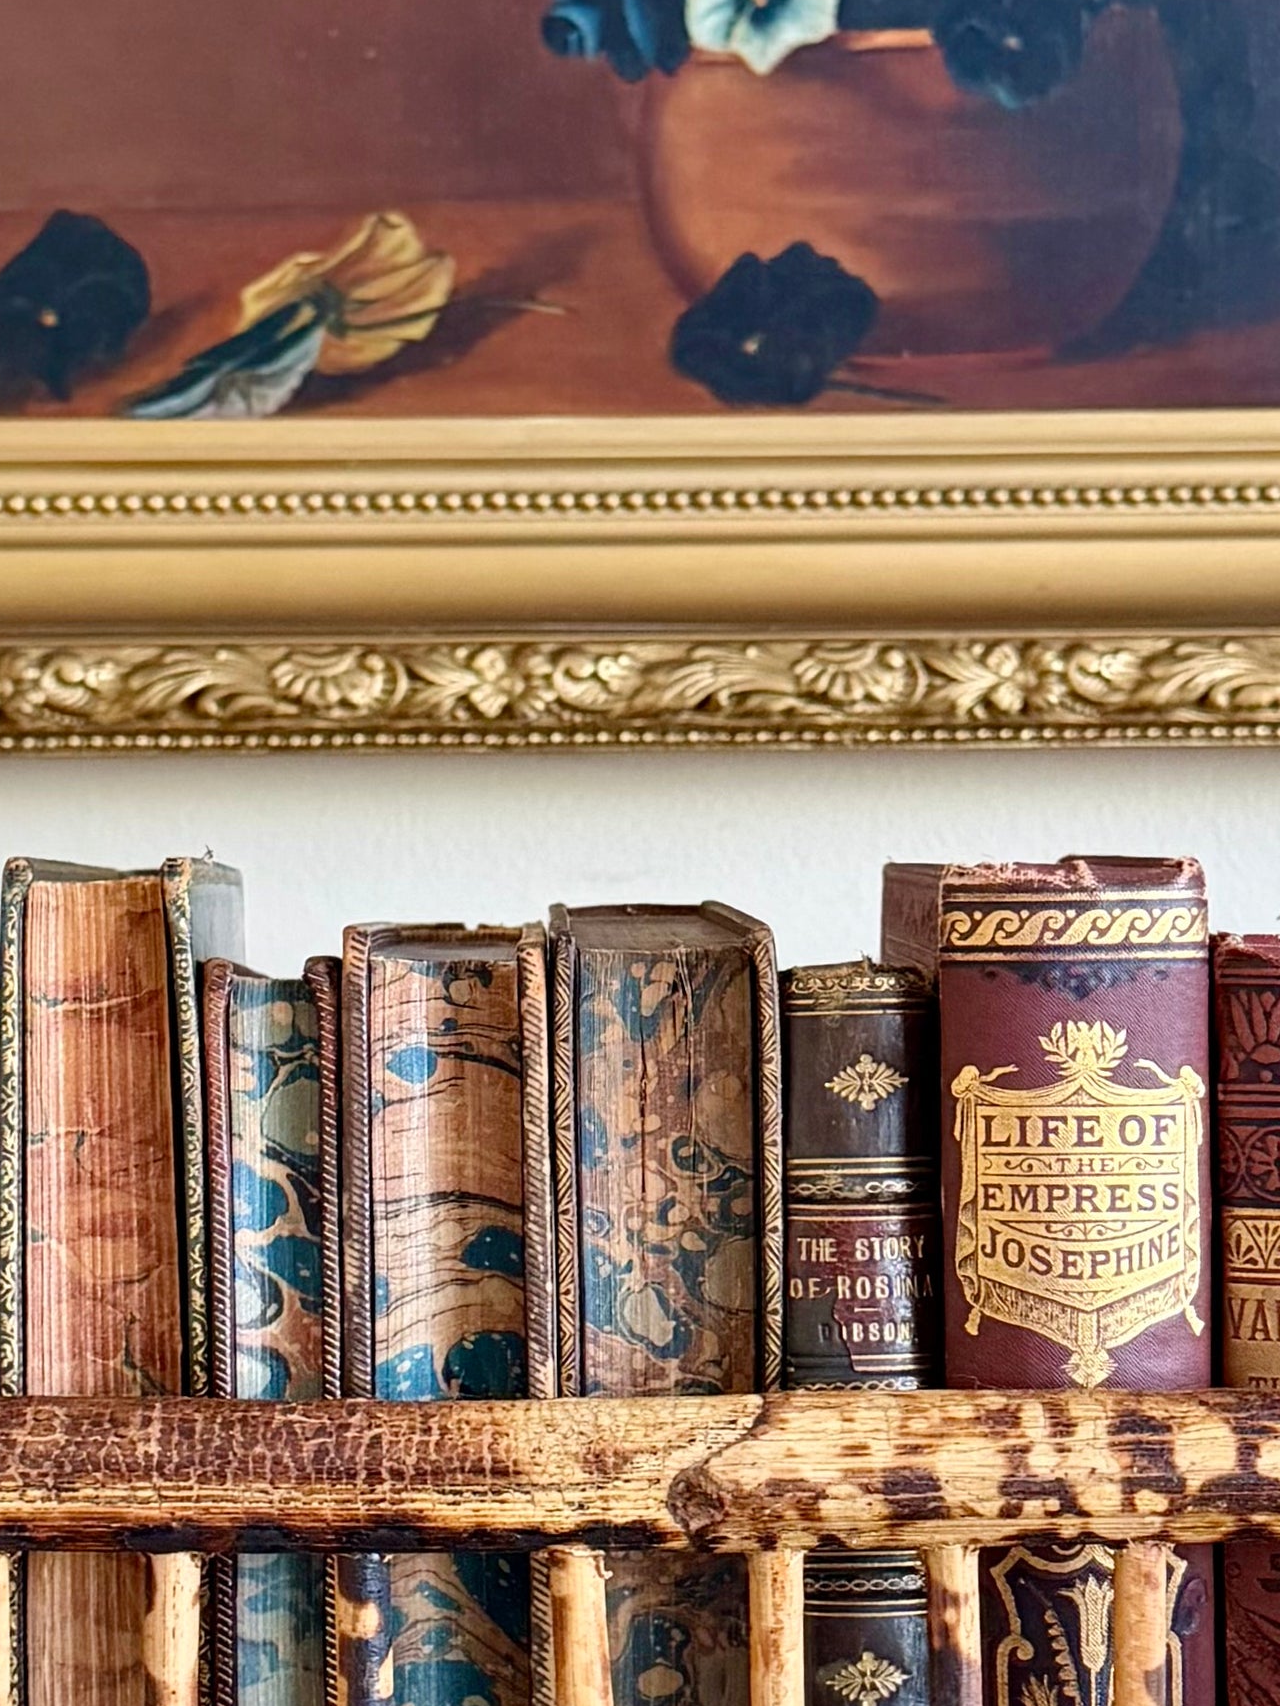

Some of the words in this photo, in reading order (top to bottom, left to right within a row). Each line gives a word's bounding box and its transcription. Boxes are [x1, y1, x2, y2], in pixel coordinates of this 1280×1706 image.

[980, 1114, 1104, 1148] LIFE
[1118, 1114, 1177, 1147] OF
[1056, 1157, 1115, 1173] THE
[980, 1182, 1180, 1213] EMPRESS
[797, 1237, 838, 1262] THE
[855, 1234, 925, 1261] STORY
[980, 1222, 1181, 1280] JOSEPHINE
[789, 1277, 822, 1299] OF
[837, 1274, 934, 1300] ROSINA
